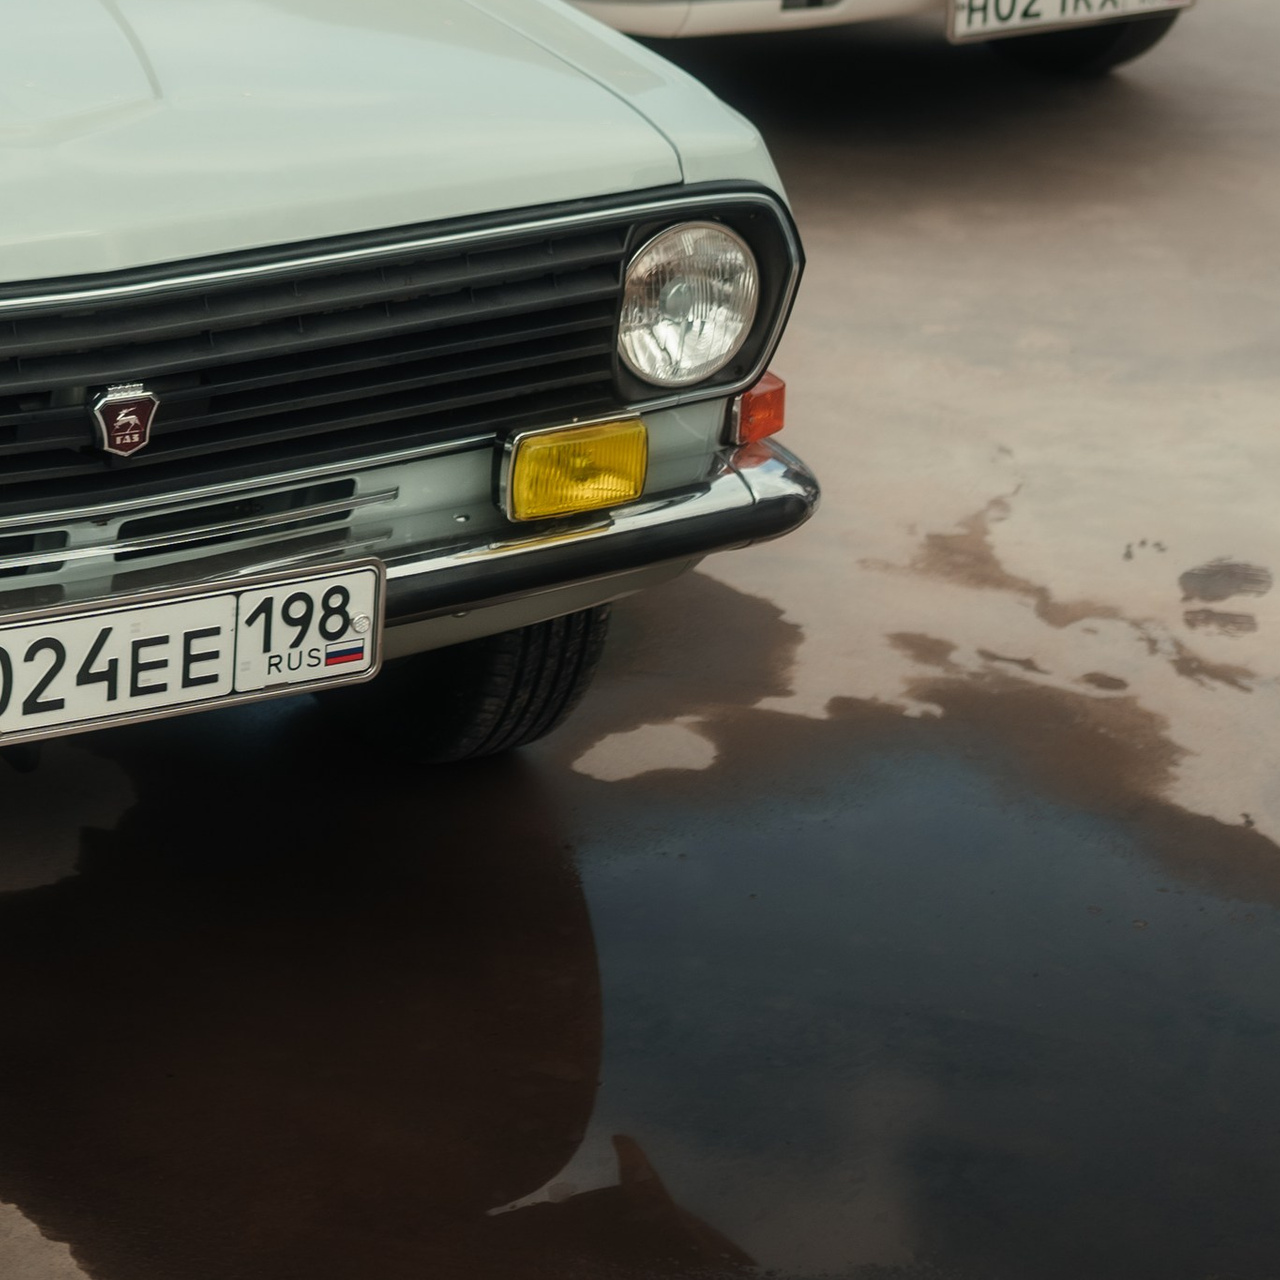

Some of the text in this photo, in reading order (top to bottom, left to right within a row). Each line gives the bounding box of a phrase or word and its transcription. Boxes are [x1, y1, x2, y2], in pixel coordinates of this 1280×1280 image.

[116, 434, 140, 445] ГАЗ
[244, 584, 351, 654] 198
[267, 647, 322, 676] RUS
